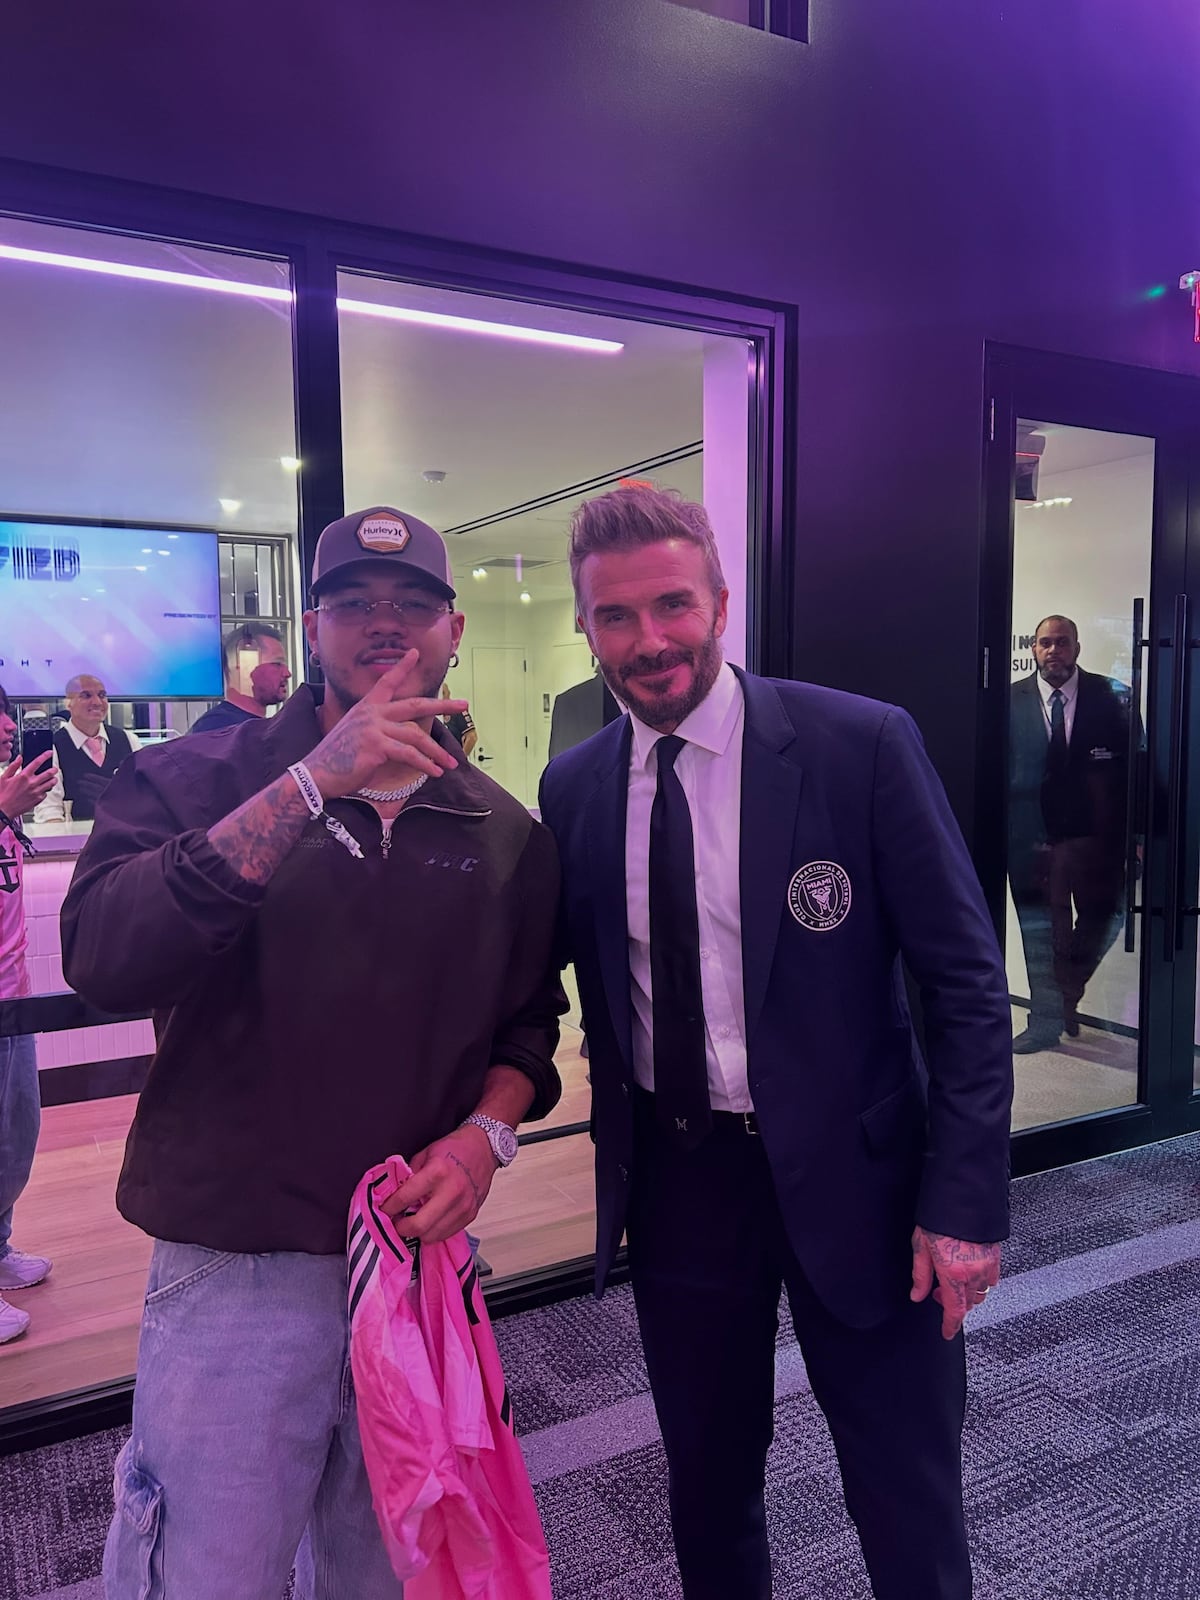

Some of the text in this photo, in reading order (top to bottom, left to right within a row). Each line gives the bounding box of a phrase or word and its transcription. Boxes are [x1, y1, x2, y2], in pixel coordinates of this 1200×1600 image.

[363, 526, 393, 535] Hurley
[791, 864, 835, 900] INTERNACIONAL
[806, 877, 832, 890] MIAMI
[793, 903, 807, 920] CLUB
[819, 917, 838, 927] MMXX
